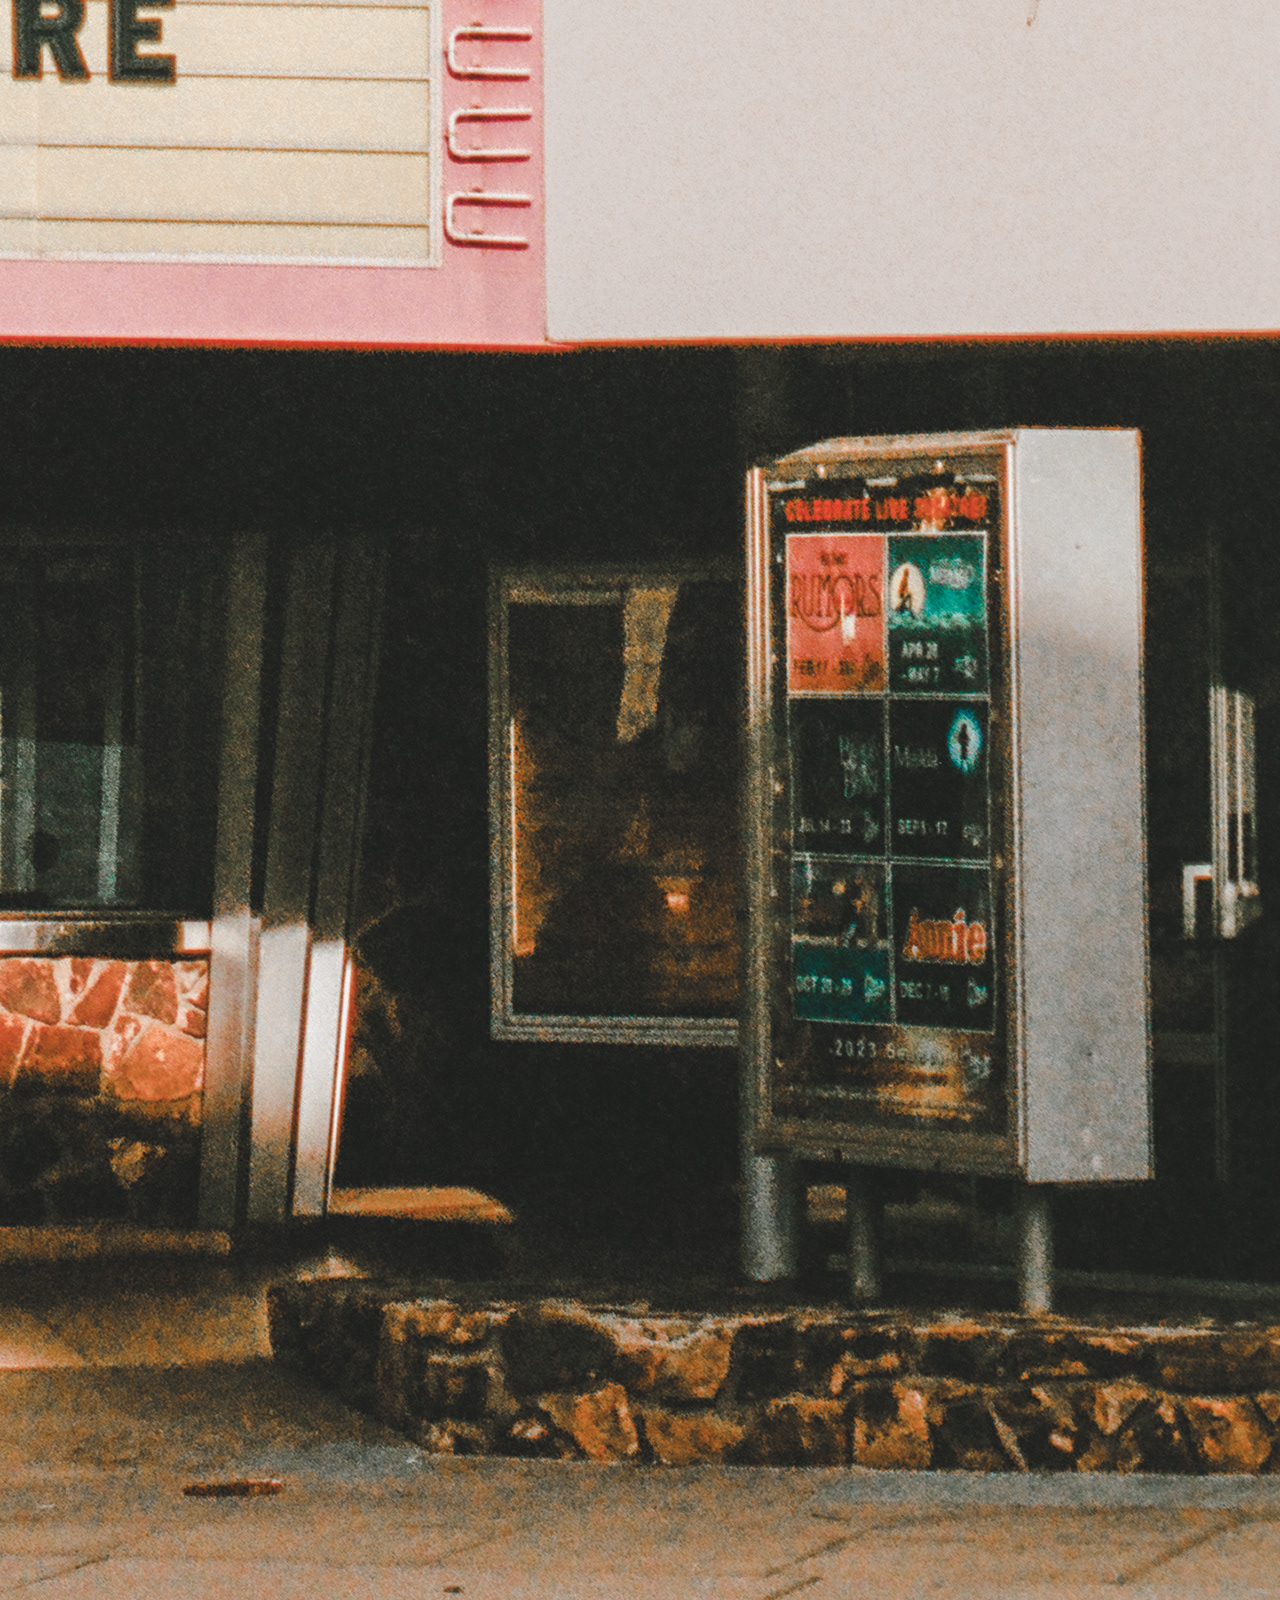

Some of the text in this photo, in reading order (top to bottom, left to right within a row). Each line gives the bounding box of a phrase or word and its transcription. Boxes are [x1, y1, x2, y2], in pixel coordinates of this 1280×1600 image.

[785, 497, 870, 521] CELEBRATE
[876, 497, 908, 520] LIVE
[790, 572, 882, 632] RUMORS
[903, 908, 989, 967] Annie
[835, 1039, 877, 1059] 2023
